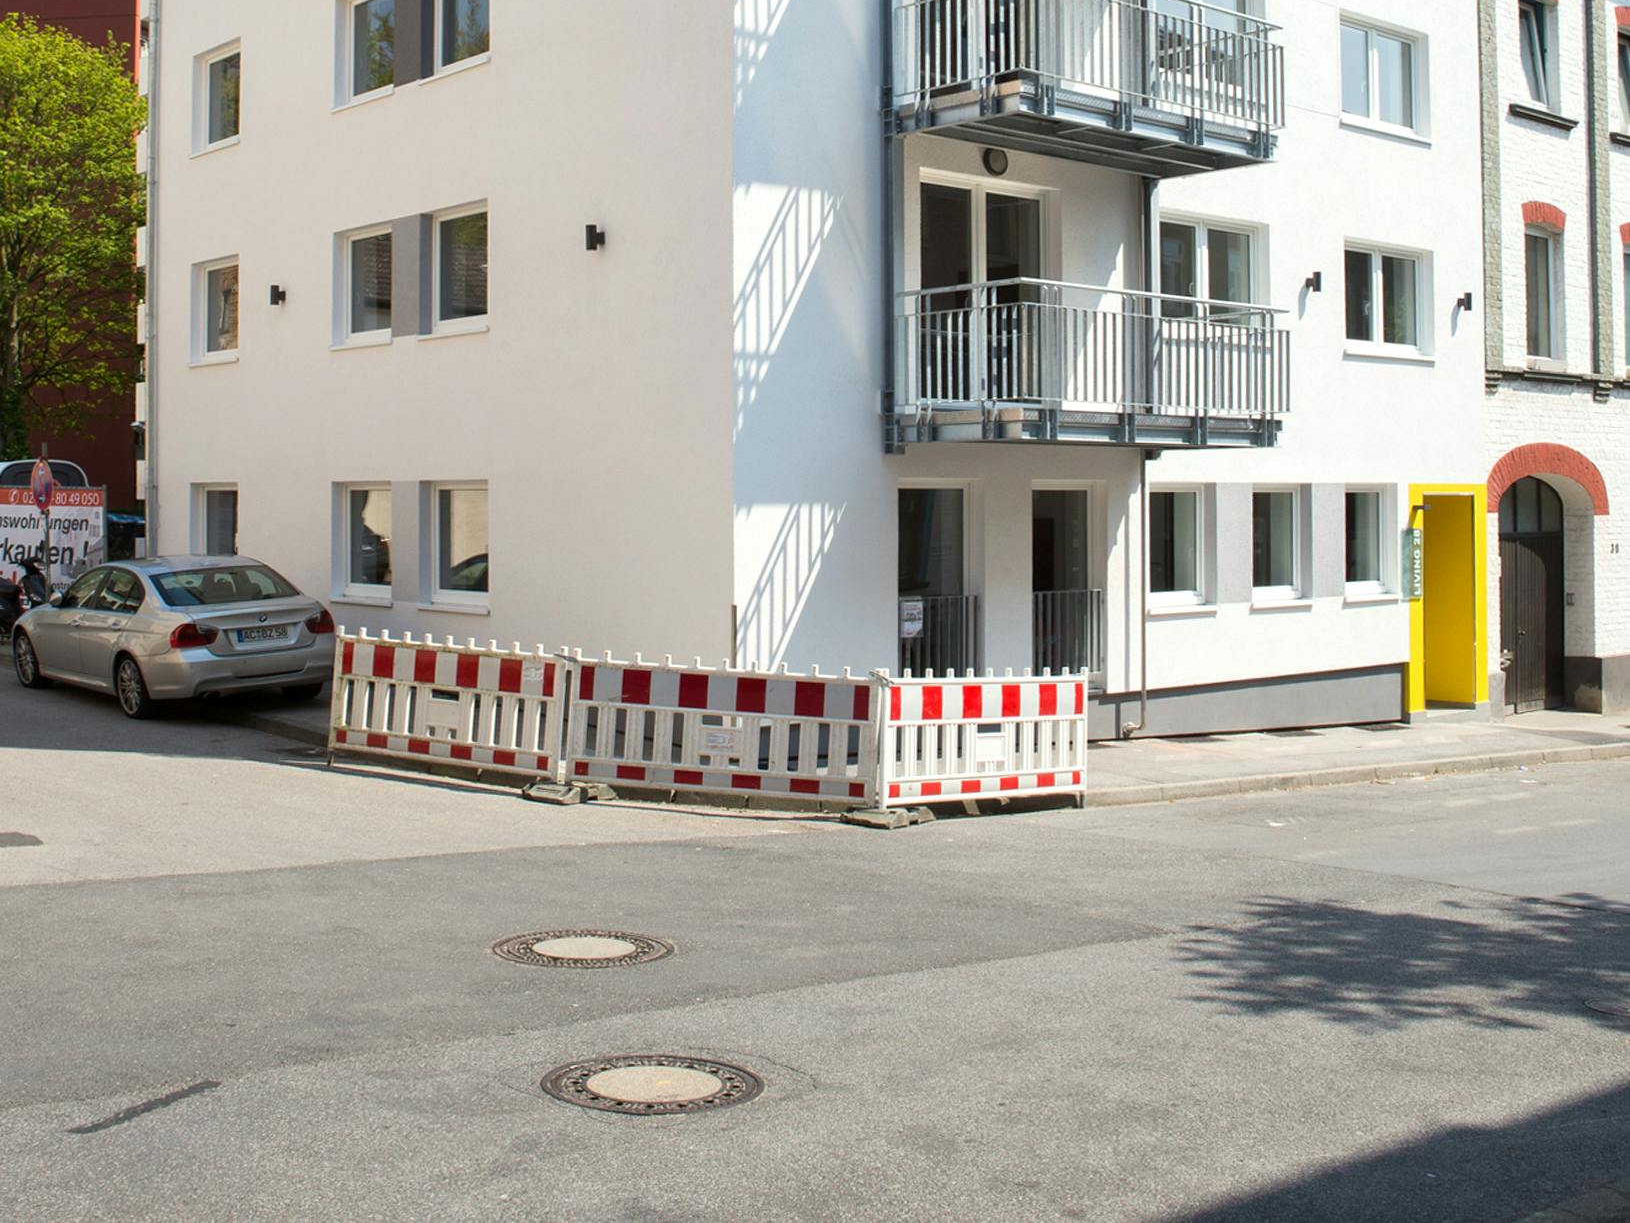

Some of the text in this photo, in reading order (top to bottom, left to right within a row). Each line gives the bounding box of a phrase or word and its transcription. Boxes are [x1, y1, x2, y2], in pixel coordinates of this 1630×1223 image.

[69, 493, 80, 505] 49
[81, 493, 100, 505] 050
[1413, 549, 1421, 596] LIVING
